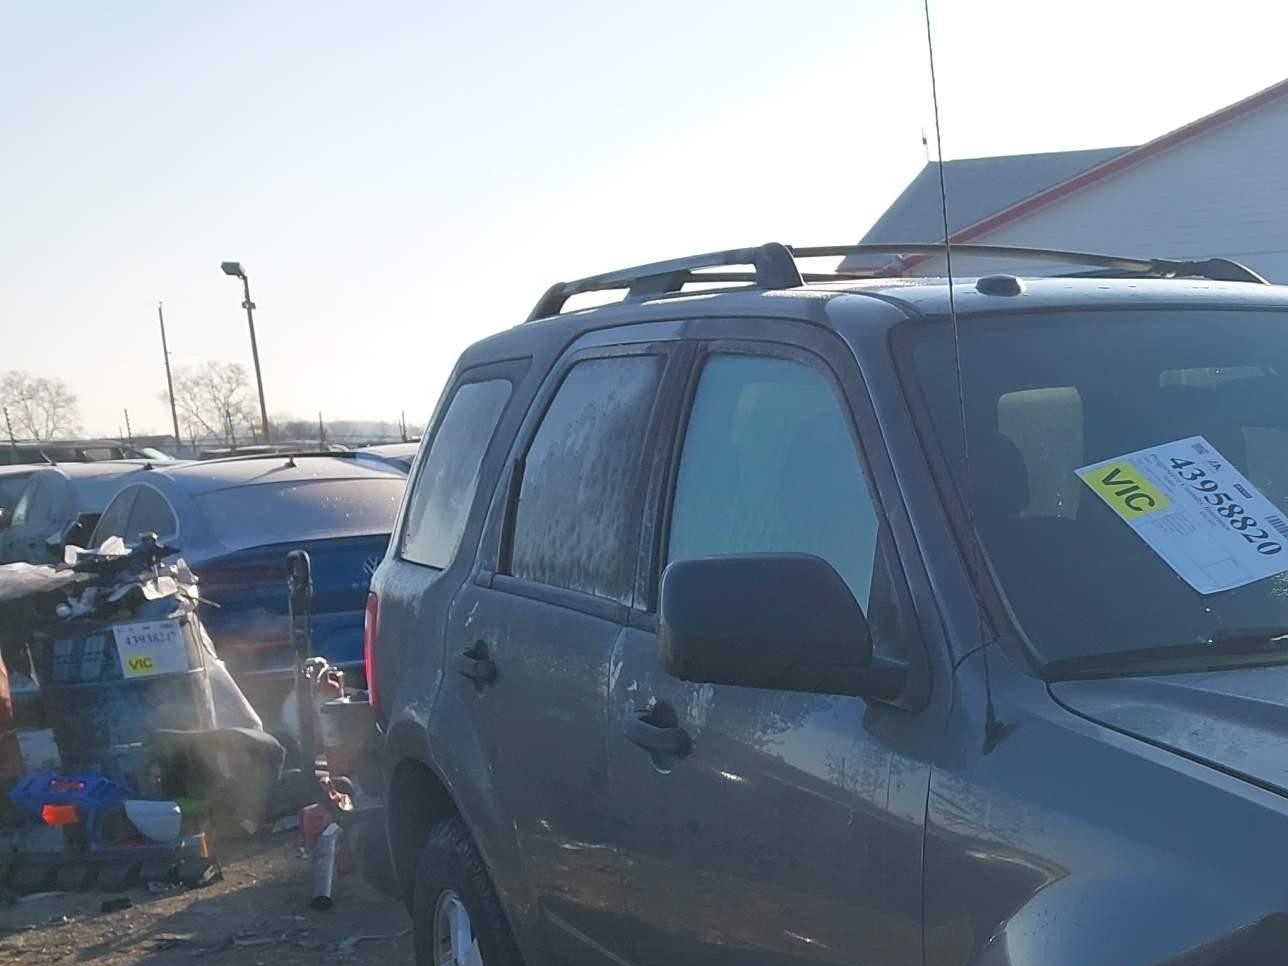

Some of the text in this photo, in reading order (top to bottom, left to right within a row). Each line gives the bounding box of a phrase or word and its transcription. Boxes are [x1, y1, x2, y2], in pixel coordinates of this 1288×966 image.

[1100, 467, 1156, 512] VIC
[1169, 456, 1283, 556] 43958820
[128, 656, 153, 670] VIC
